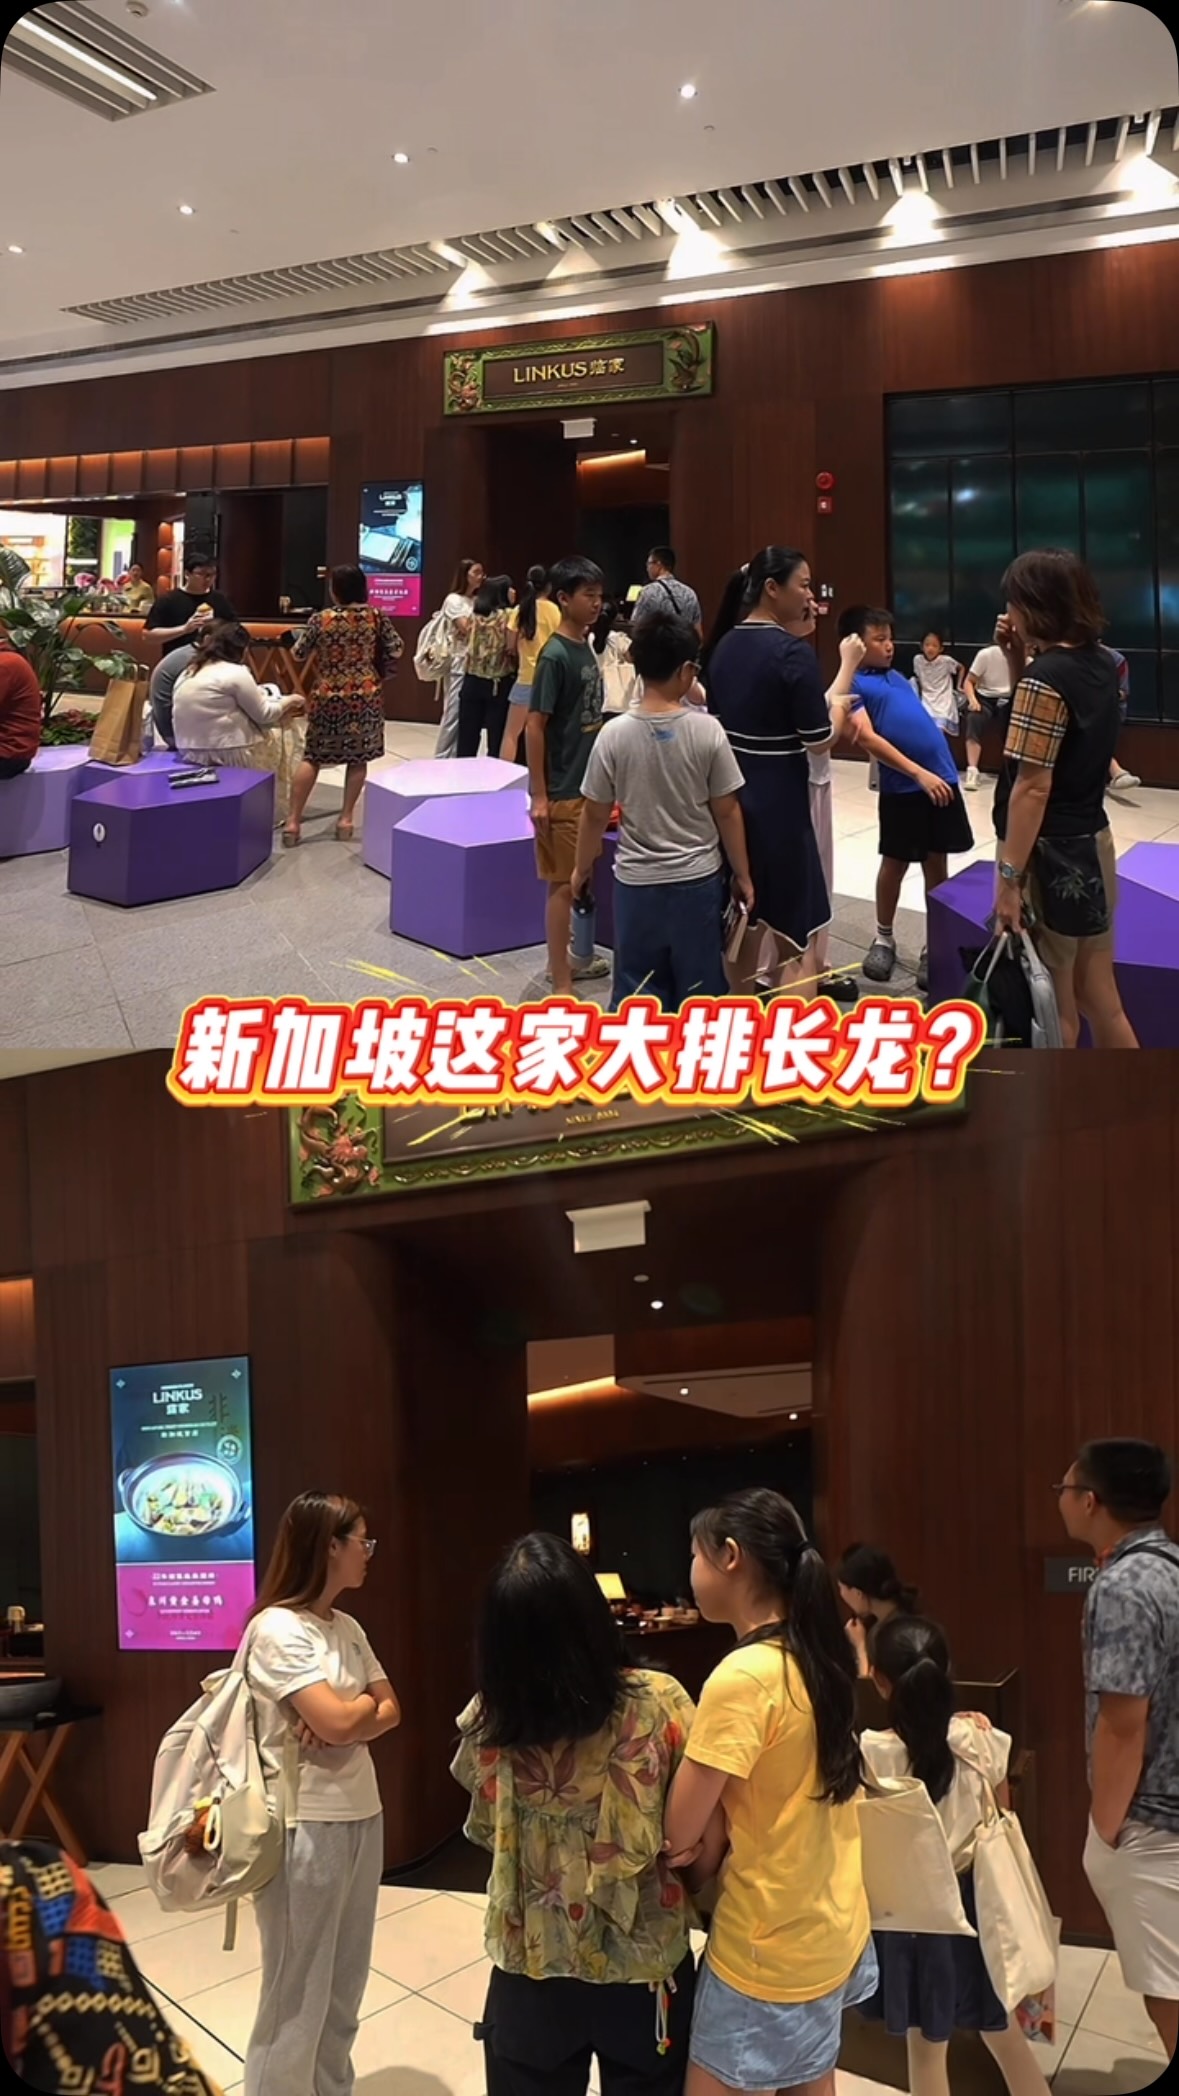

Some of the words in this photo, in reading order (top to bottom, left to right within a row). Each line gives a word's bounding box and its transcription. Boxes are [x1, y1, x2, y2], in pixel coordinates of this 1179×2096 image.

[513, 361, 587, 383] LINKUS
[152, 1388, 203, 1404] LINKUS
[1068, 1566, 1099, 1583] FIR
